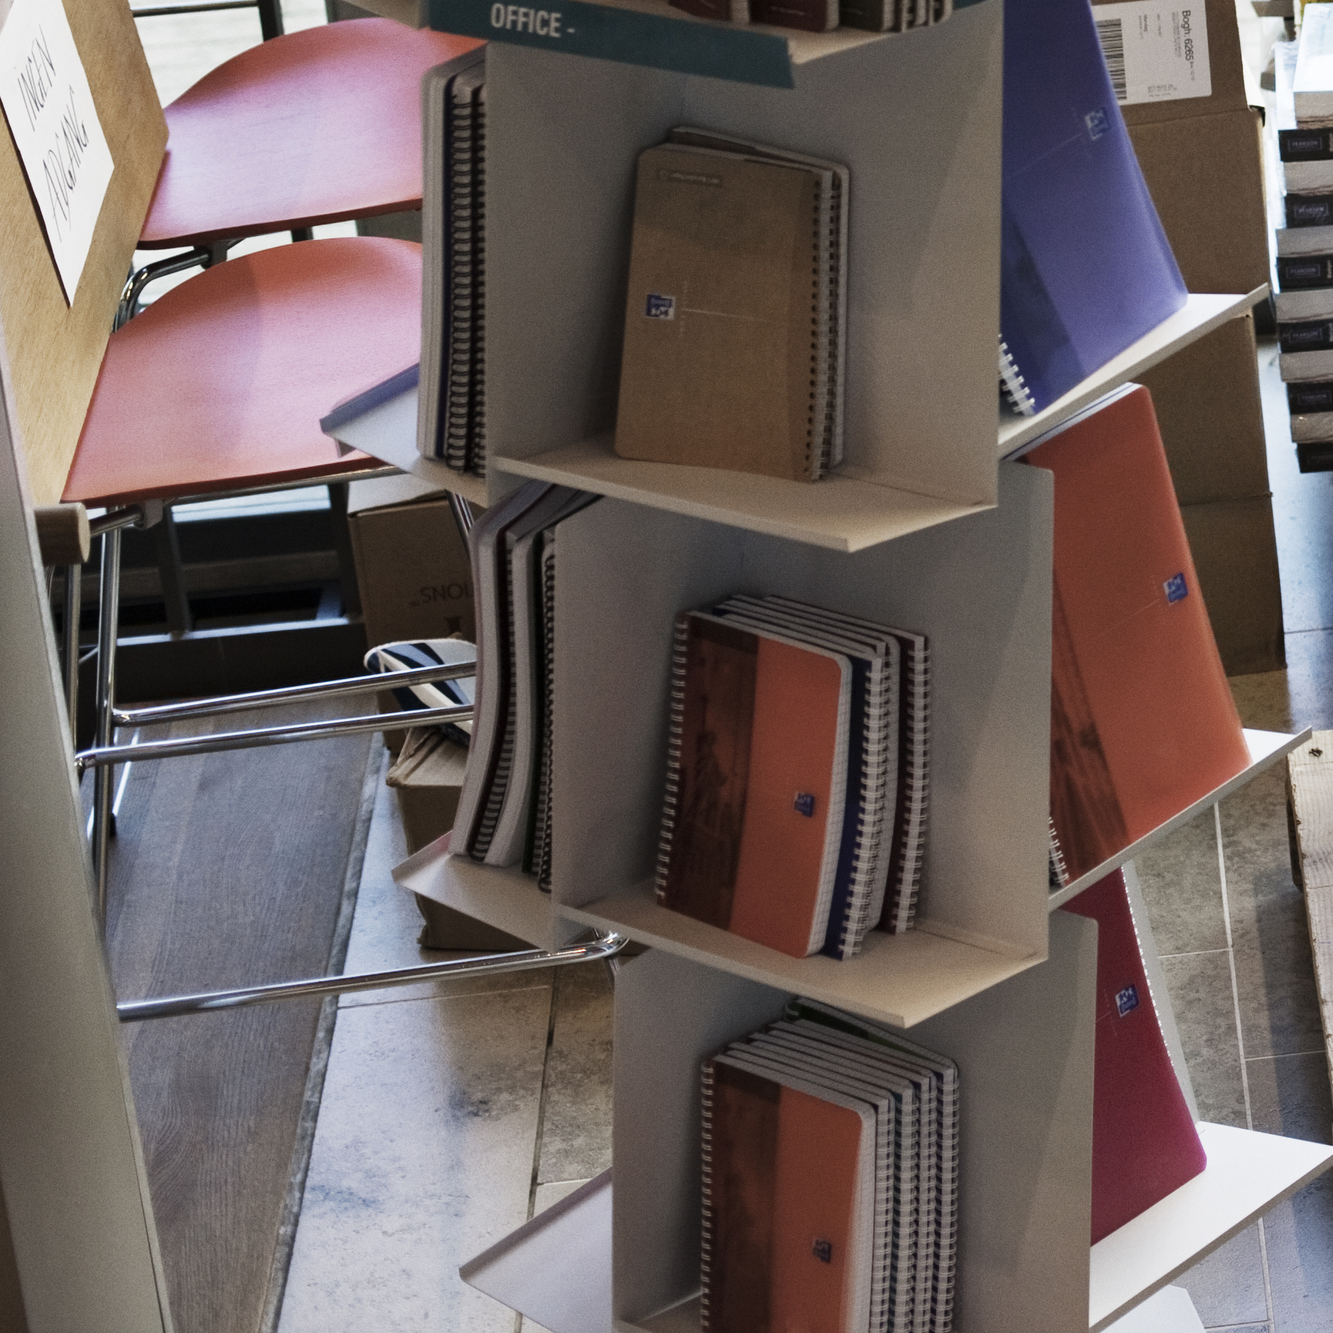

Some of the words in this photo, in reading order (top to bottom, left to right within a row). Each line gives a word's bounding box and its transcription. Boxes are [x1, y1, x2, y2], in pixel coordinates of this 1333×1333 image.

[490, 3, 562, 38] OFFICE
[1184, 38, 1195, 61] 6265
[17, 24, 56, 132] INGEN
[42, 84, 89, 243] ADGANG
